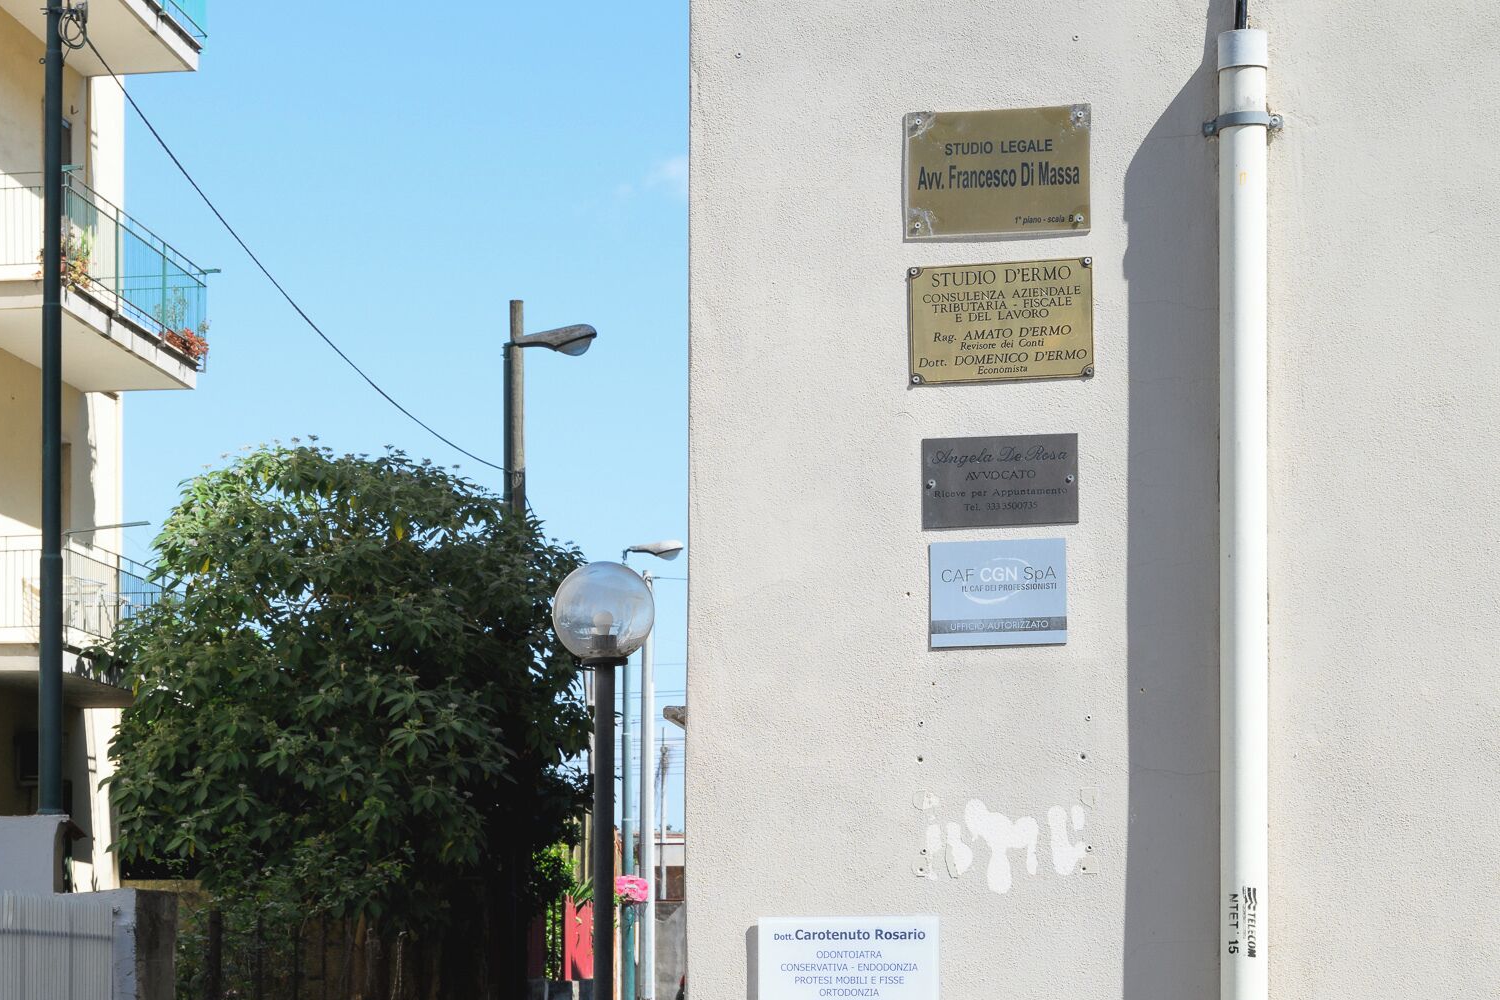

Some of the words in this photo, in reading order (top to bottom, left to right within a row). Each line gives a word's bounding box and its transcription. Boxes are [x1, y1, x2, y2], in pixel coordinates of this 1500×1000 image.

[945, 141, 993, 156] STUDIO
[1001, 139, 1053, 153] LEGALE
[918, 167, 944, 190] Avv.
[949, 165, 1016, 189] Francesco
[1021, 162, 1034, 187] Di
[1038, 161, 1080, 186] Massa
[1023, 216, 1042, 226] piano
[1047, 214, 1065, 223] scala
[931, 270, 996, 287] STUDIO
[1004, 266, 1071, 284] D'ERMO
[922, 291, 1005, 304] CONSULENZA
[1012, 285, 1081, 299] AZIENDALE
[932, 302, 1007, 314] TRIBUTARIA
[1023, 297, 1072, 308] FISCALE
[955, 313, 962, 322] E
[968, 311, 991, 322] DEL
[998, 309, 1049, 321] LAVORO
[933, 332, 957, 344] Rag.
[964, 328, 1013, 341] AMATO
[1019, 325, 1072, 338] D'ERMO
[960, 341, 996, 351] Revisore
[1001, 340, 1014, 349] dei
[1019, 338, 1044, 348] Conti
[918, 357, 947, 368] Dott.
[954, 352, 1028, 366] DOMENICO
[1034, 349, 1087, 363] D'ERMO
[977, 365, 1028, 375] Economista
[931, 448, 994, 468] Angela
[997, 446, 1022, 463] De
[1024, 445, 1068, 462] Rosa
[965, 470, 1036, 482] AVVOCATO
[934, 490, 966, 499] Riceve
[971, 489, 987, 499] per
[992, 487, 1068, 497] Appuntamento
[964, 503, 981, 512] Tel.
[941, 569, 974, 583] CAF
[980, 567, 1018, 583] CGN
[1023, 566, 1057, 583] SpA
[961, 585, 968, 593] IL
[969, 585, 982, 593] CAF
[985, 584, 997, 592] DEI
[998, 583, 1057, 592] PROFESSIONISTI
[950, 622, 985, 631] UFFICIO
[987, 620, 1049, 630] AUTORIZZATO
[773, 932, 795, 941] Dott.
[794, 929, 871, 941] Carotenuto
[875, 929, 926, 940] Rosario
[1247, 913, 1256, 958] TELECOM
[1228, 939, 1239, 954] 15
[816, 950, 882, 959] ODONTOIATRA
[780, 963, 848, 972] CONSERVATIVA
[857, 963, 918, 972] ENDODONZIA
[794, 976, 833, 985] PROTESI
[835, 976, 868, 985] MOBILI
[871, 976, 876, 984] E
[879, 976, 905, 984] FISSE
[819, 988, 880, 997] ORTODONZIA
